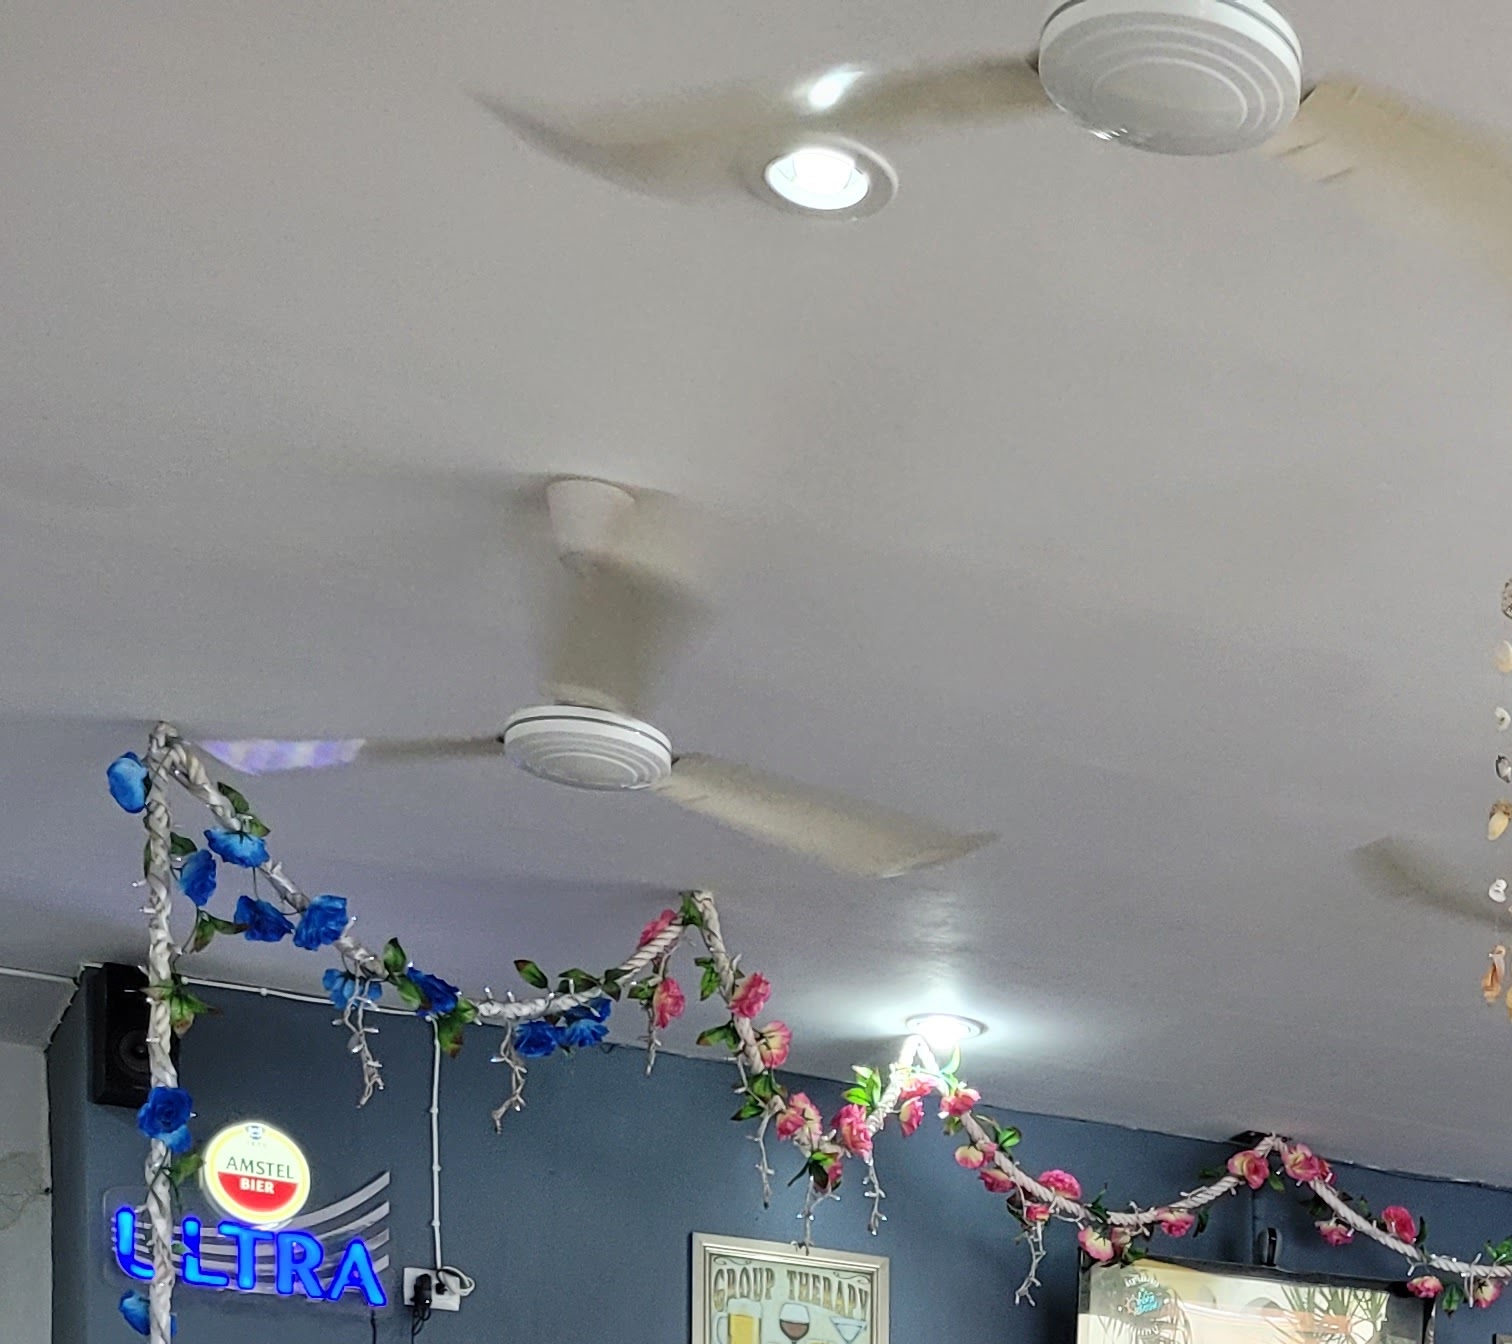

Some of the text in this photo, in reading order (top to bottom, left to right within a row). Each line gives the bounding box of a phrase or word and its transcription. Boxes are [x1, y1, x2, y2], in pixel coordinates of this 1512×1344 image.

[225, 1155, 294, 1179] AMSTEL
[239, 1176, 275, 1195] BIER
[712, 1267, 868, 1320] GROUP THERAPY
